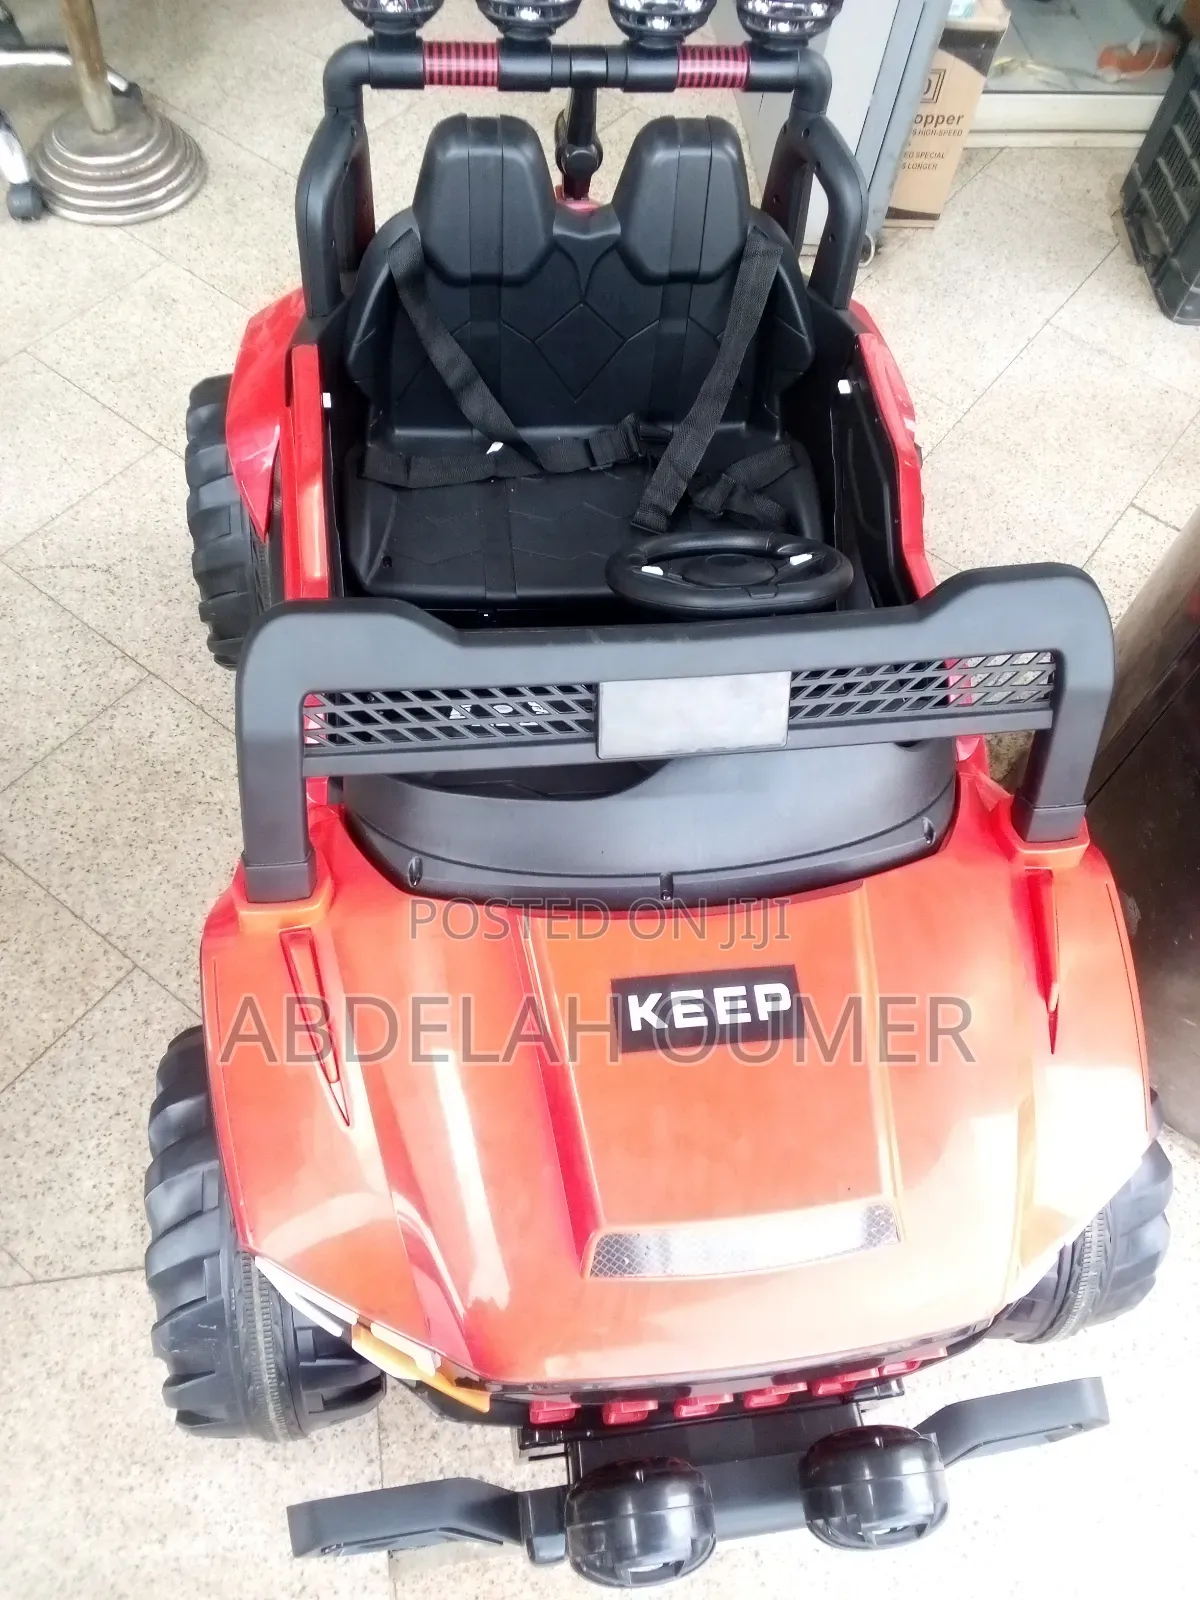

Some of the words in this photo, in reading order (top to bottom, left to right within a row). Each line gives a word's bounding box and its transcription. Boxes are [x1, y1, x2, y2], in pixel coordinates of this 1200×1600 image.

[914, 113, 964, 128] opper
[918, 129, 963, 137] HIGH-SPEED
[915, 151, 945, 159] SPECIAL
[907, 162, 938, 170] LONGER
[627, 983, 792, 1032] KEEP
